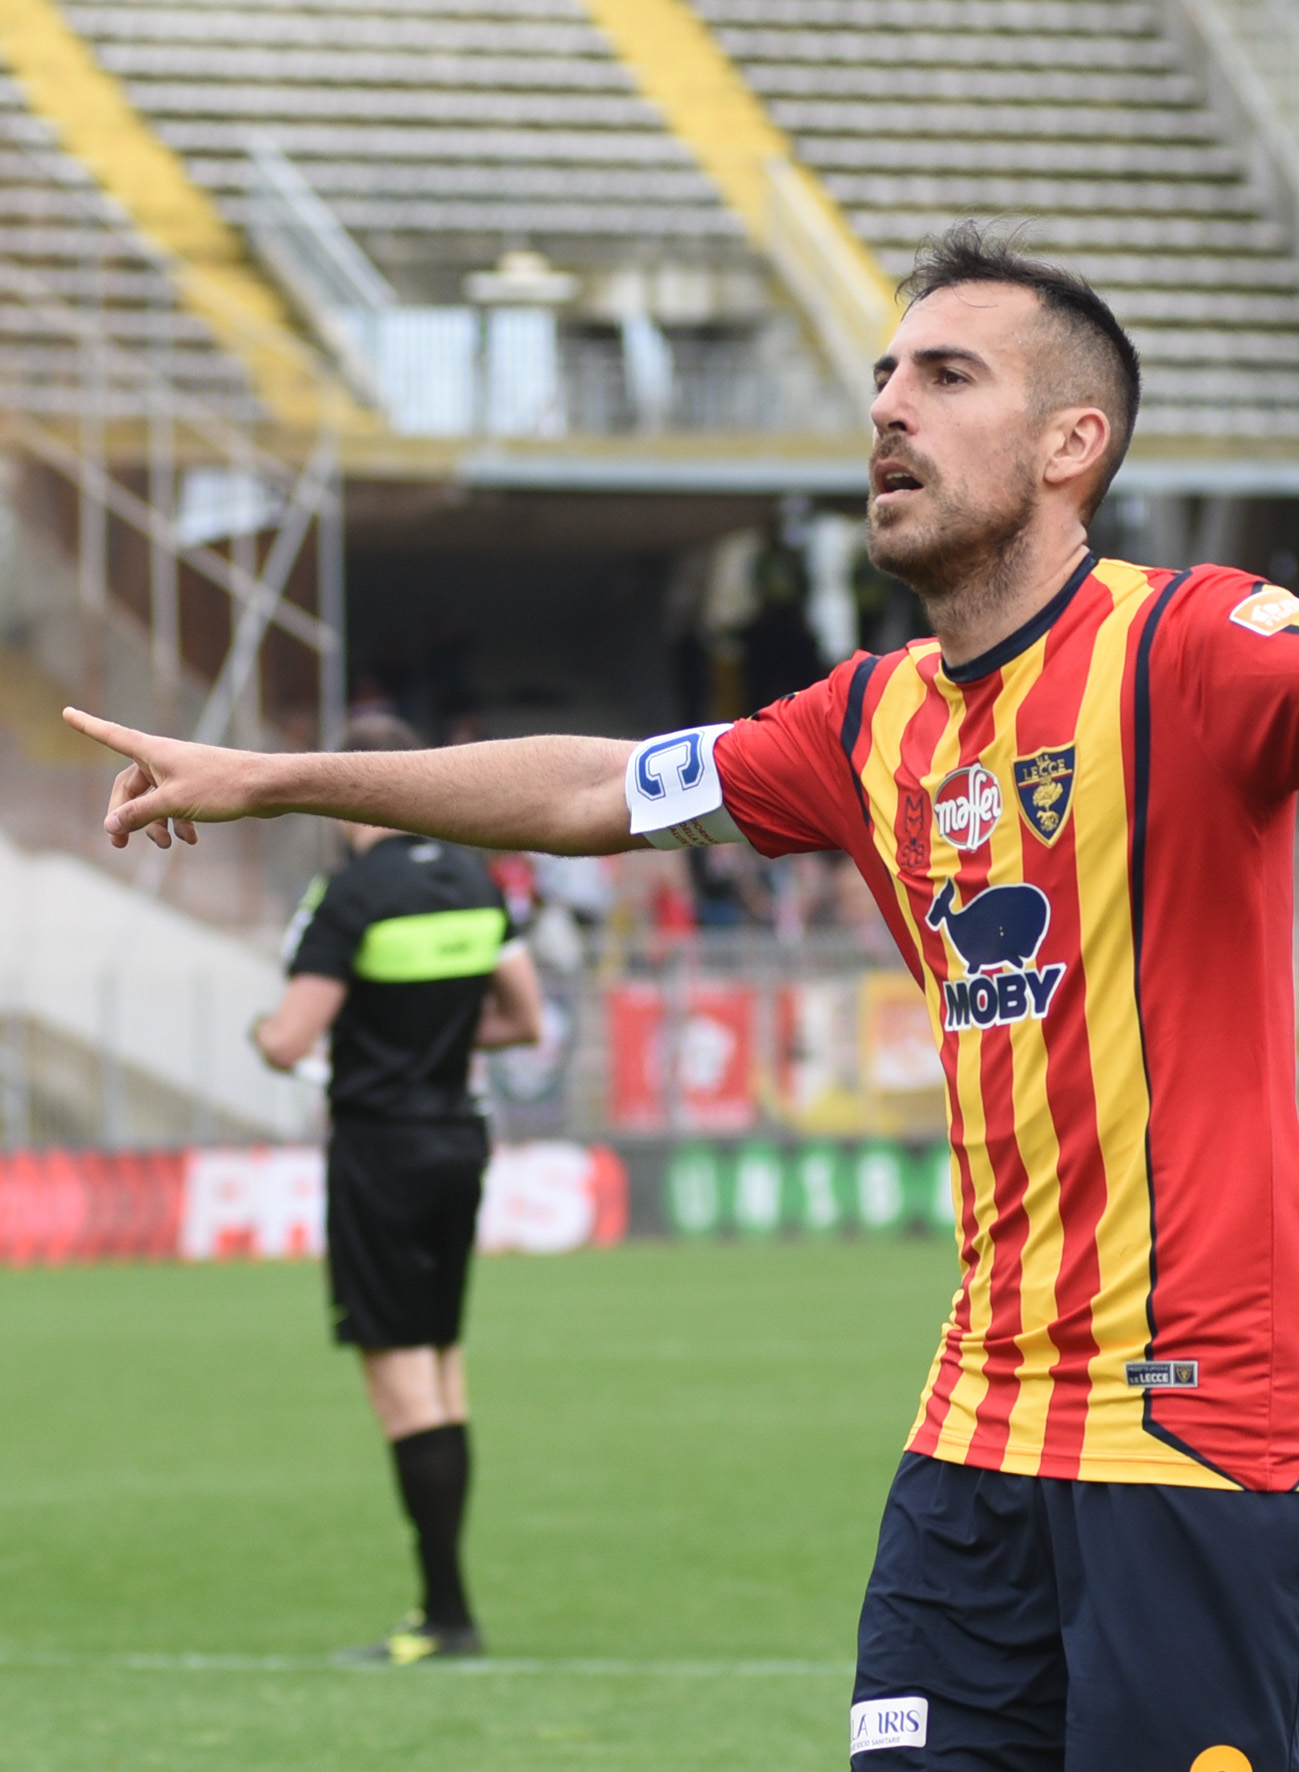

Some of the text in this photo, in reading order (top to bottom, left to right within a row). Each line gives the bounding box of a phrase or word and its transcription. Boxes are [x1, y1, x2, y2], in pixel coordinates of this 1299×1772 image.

[635, 730, 705, 801] C
[1023, 758, 1066, 781] LECCE
[934, 763, 1002, 851] maffei
[943, 961, 1067, 1031] MOBY
[1140, 1372, 1169, 1383] LECCE
[878, 1709, 921, 1734] IRIS
